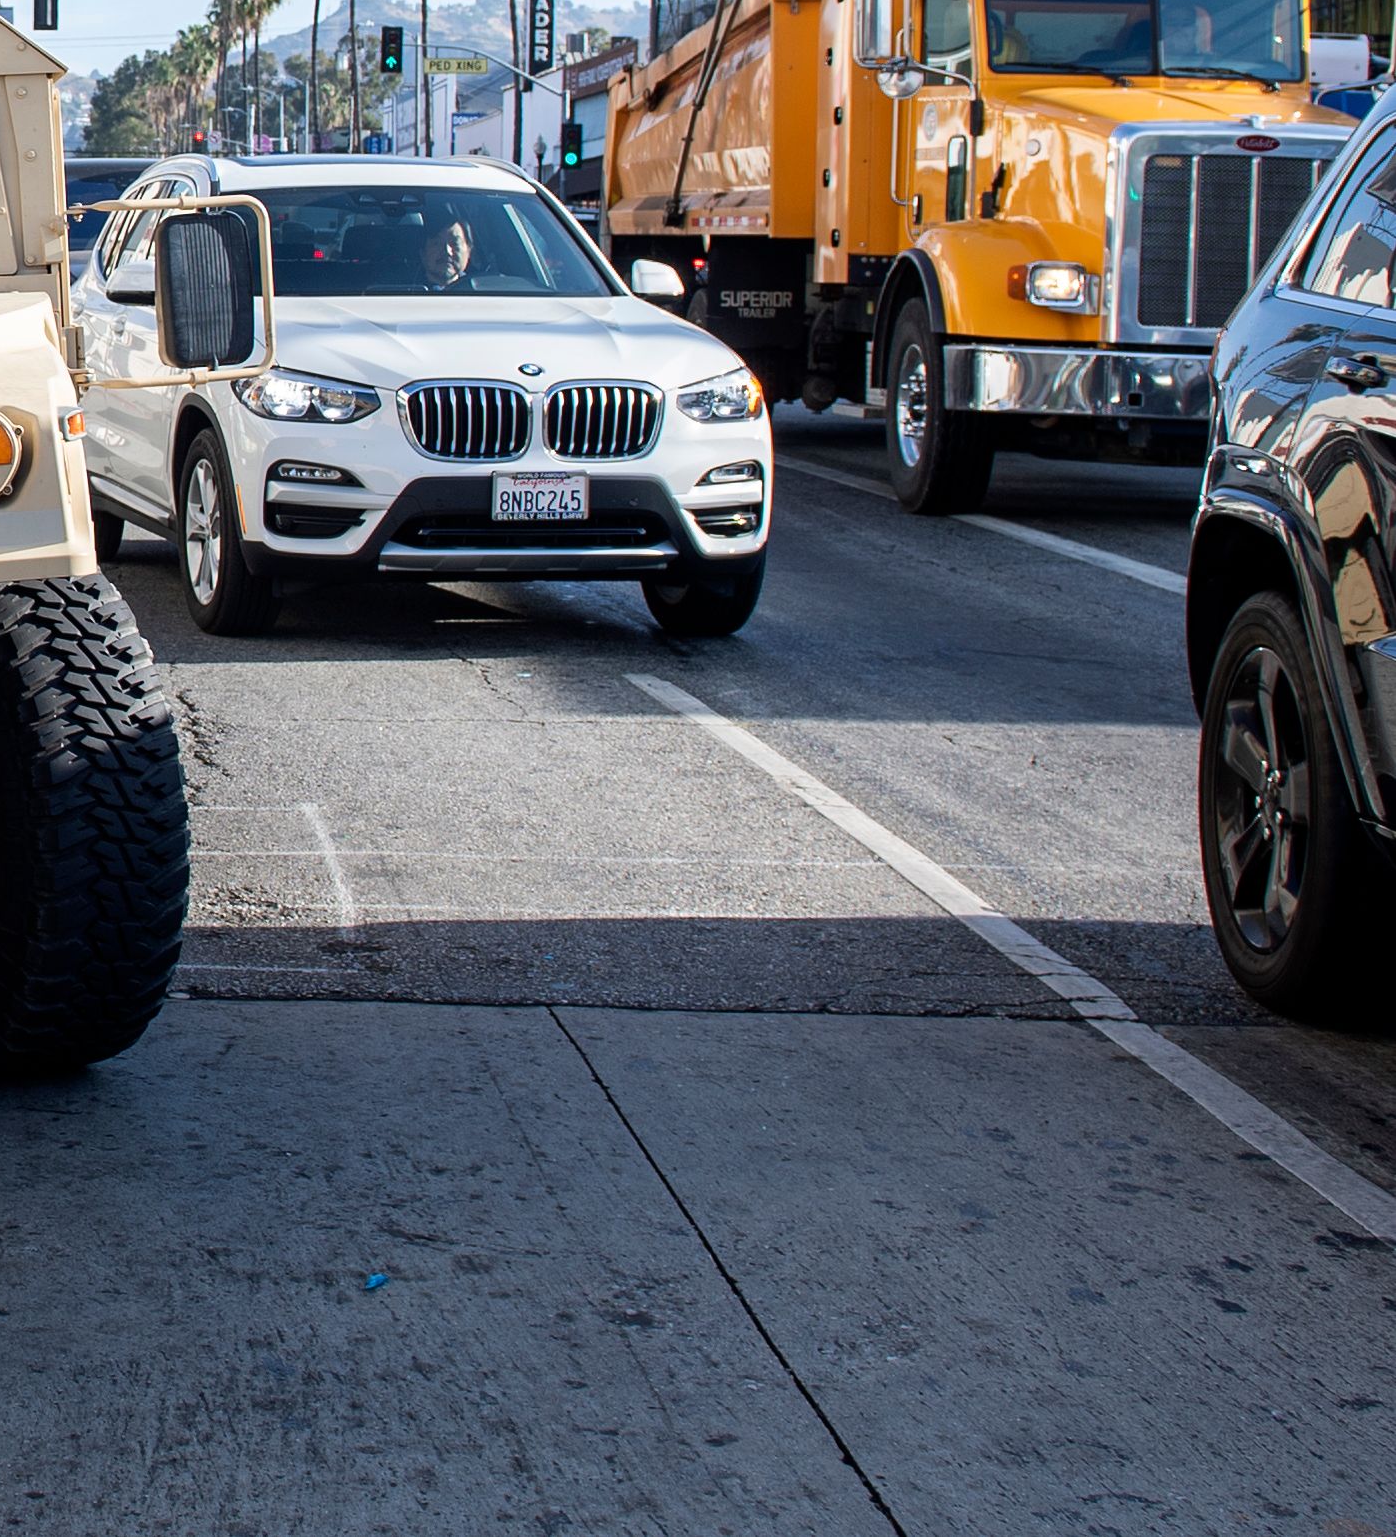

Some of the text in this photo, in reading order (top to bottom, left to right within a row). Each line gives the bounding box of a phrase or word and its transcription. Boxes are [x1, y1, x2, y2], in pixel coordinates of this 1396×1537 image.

[429, 61, 482, 71] PED XING
[720, 290, 793, 308] SUPERIOR
[737, 308, 776, 318] TRAILER
[499, 490, 582, 511] 8NBC245
